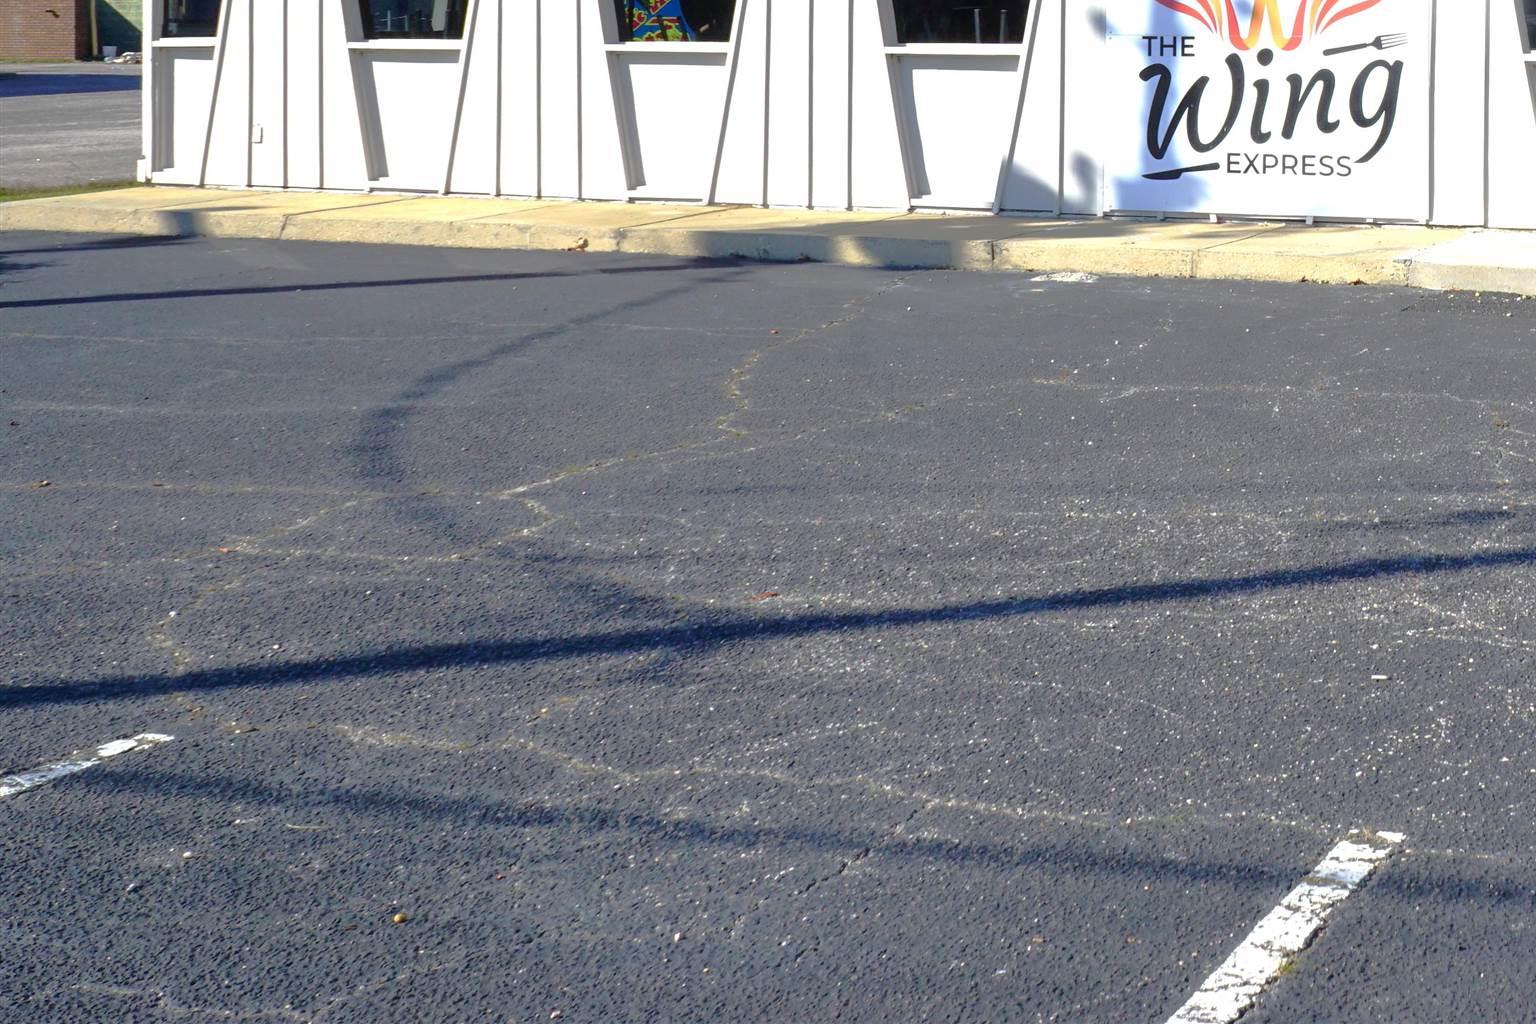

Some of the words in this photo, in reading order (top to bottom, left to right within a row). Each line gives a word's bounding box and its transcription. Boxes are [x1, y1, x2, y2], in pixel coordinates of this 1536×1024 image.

[1142, 35, 1196, 57] THE
[1138, 48, 1404, 164] Wing
[1226, 152, 1352, 177] EXPRESS
